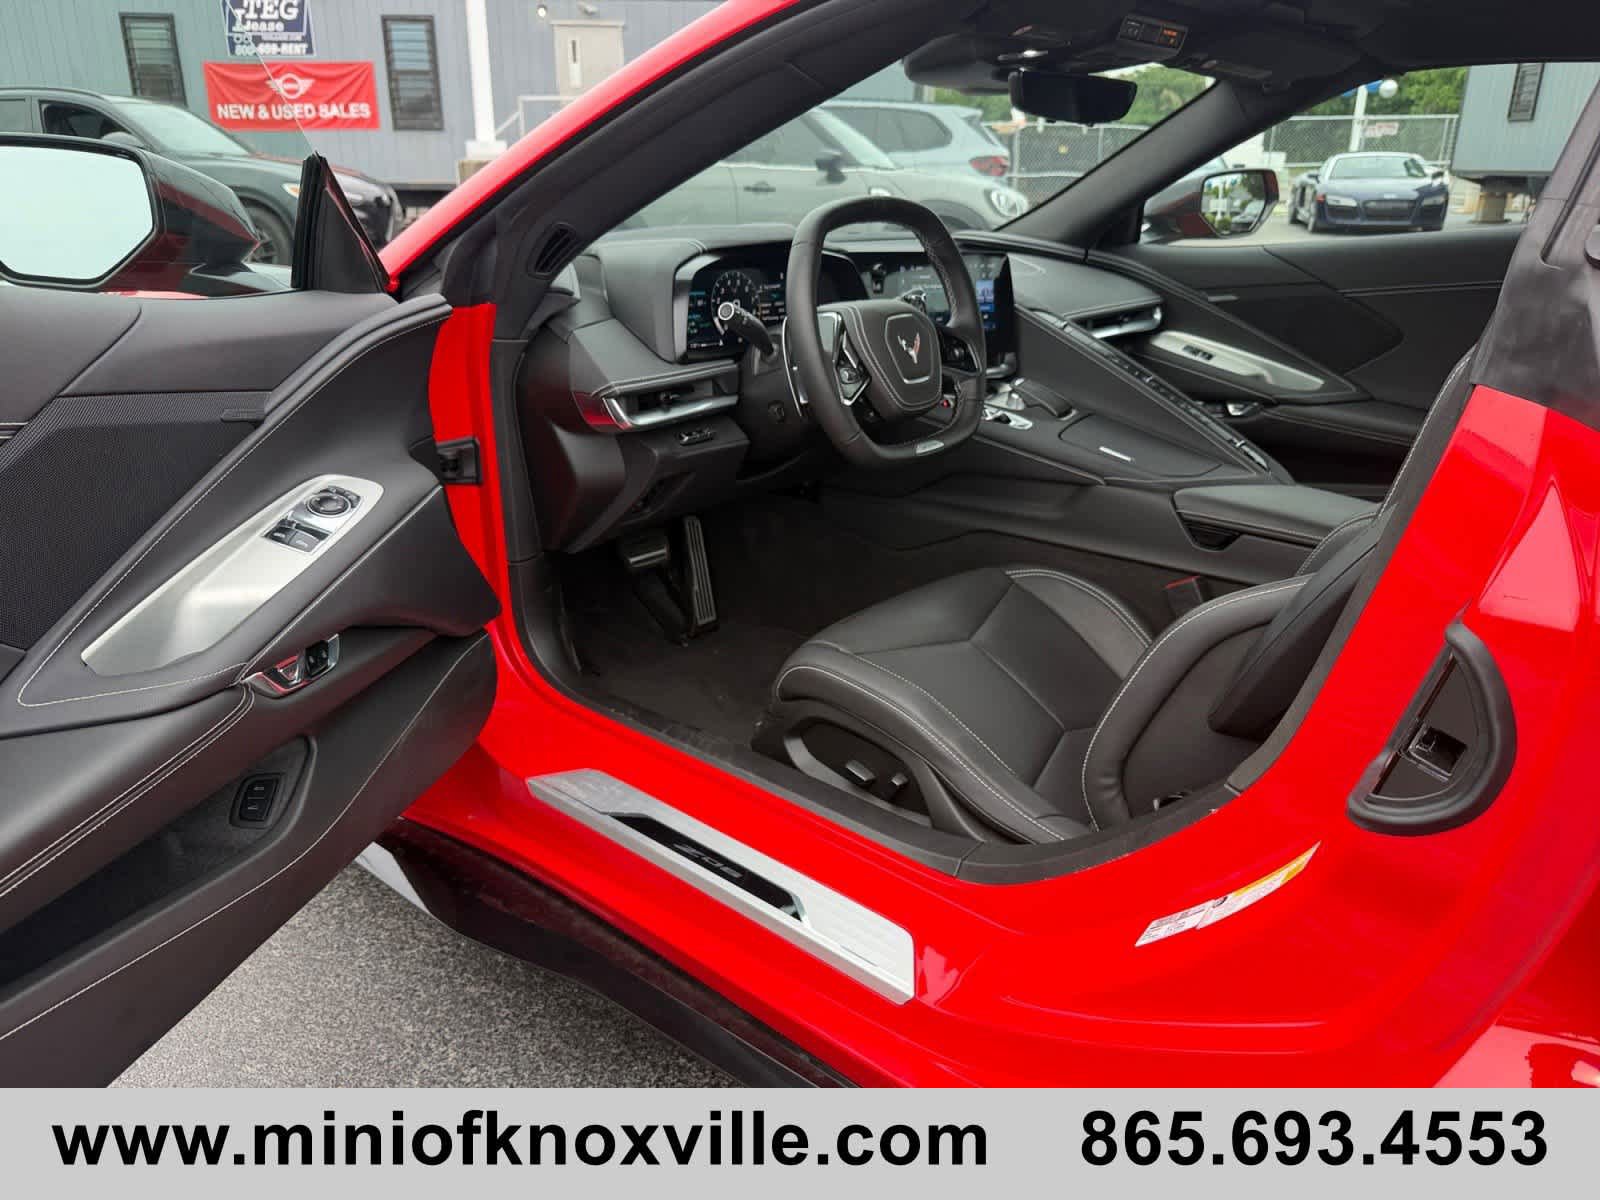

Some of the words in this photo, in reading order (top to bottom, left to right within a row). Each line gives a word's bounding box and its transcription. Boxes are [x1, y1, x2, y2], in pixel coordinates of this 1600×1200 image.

[216, 103, 254, 120] NEW
[258, 103, 270, 120] &
[272, 103, 315, 120] USED
[319, 103, 371, 120] SALES
